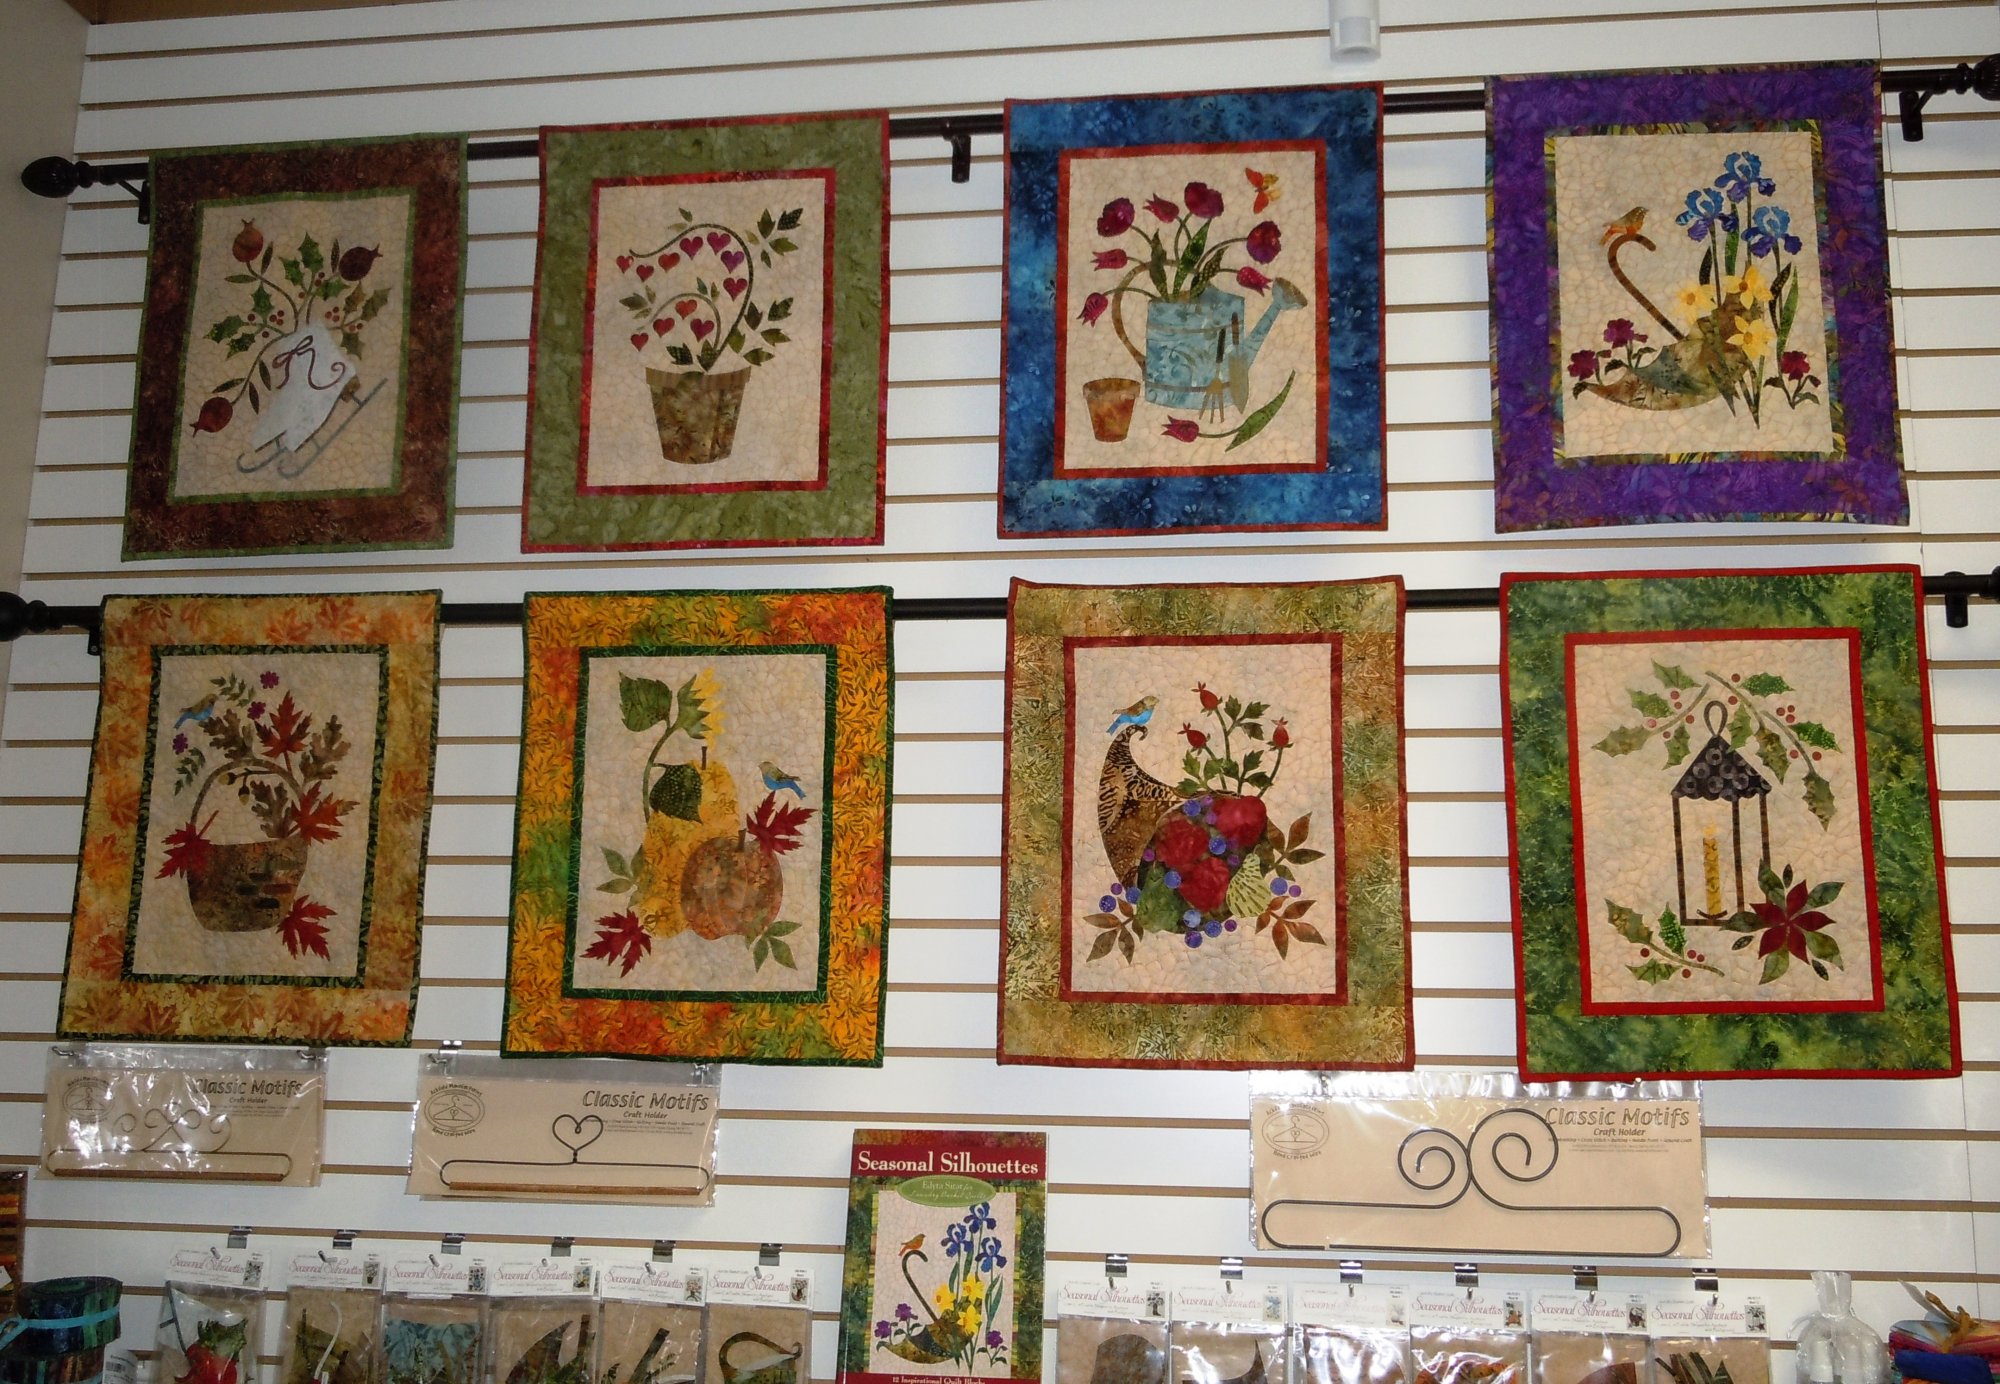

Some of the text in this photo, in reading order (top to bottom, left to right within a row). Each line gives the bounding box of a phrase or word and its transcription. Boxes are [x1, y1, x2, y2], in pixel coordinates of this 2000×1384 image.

[582, 1090, 710, 1113] Classic Motifs
[623, 1110, 668, 1119] Craft Holder
[1545, 1107, 1690, 1128] Classic Motifs
[1593, 1127, 1646, 1136] Craft Holder
[858, 1150, 1039, 1174] Seasonal Silhouettes
